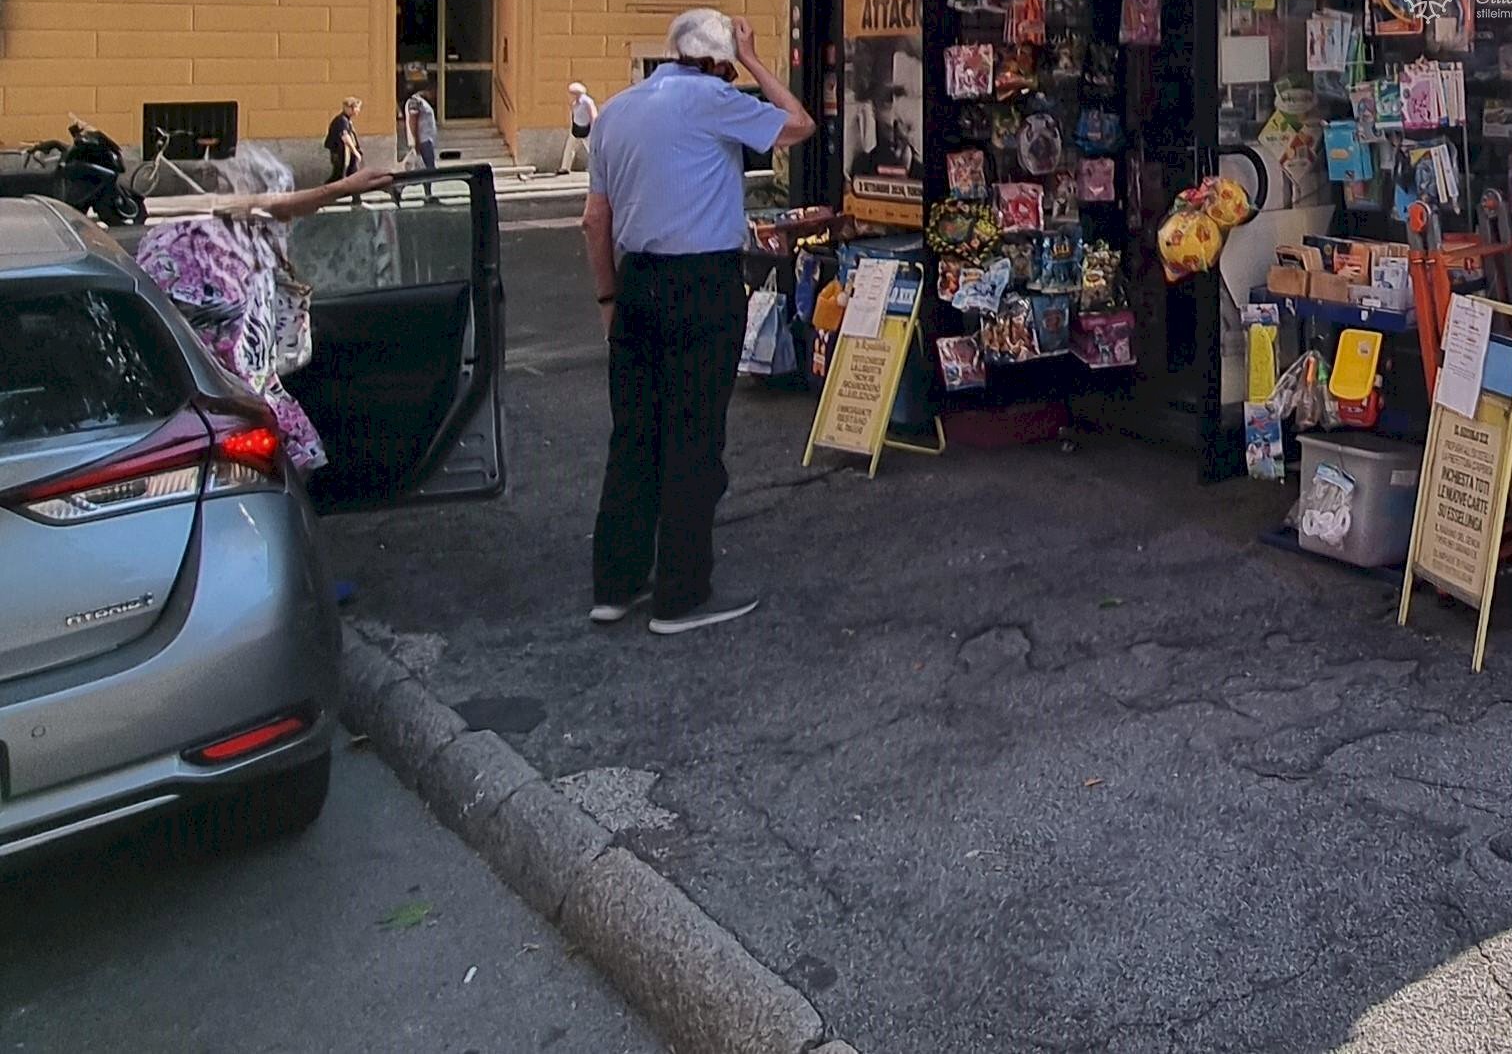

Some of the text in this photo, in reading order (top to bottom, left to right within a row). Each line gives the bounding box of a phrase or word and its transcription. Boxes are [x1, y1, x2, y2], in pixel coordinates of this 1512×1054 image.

[1441, 465, 1474, 491] INCHIESTA
[1466, 494, 1489, 516] CARTE
[1447, 506, 1483, 534] ESSELUNGA
